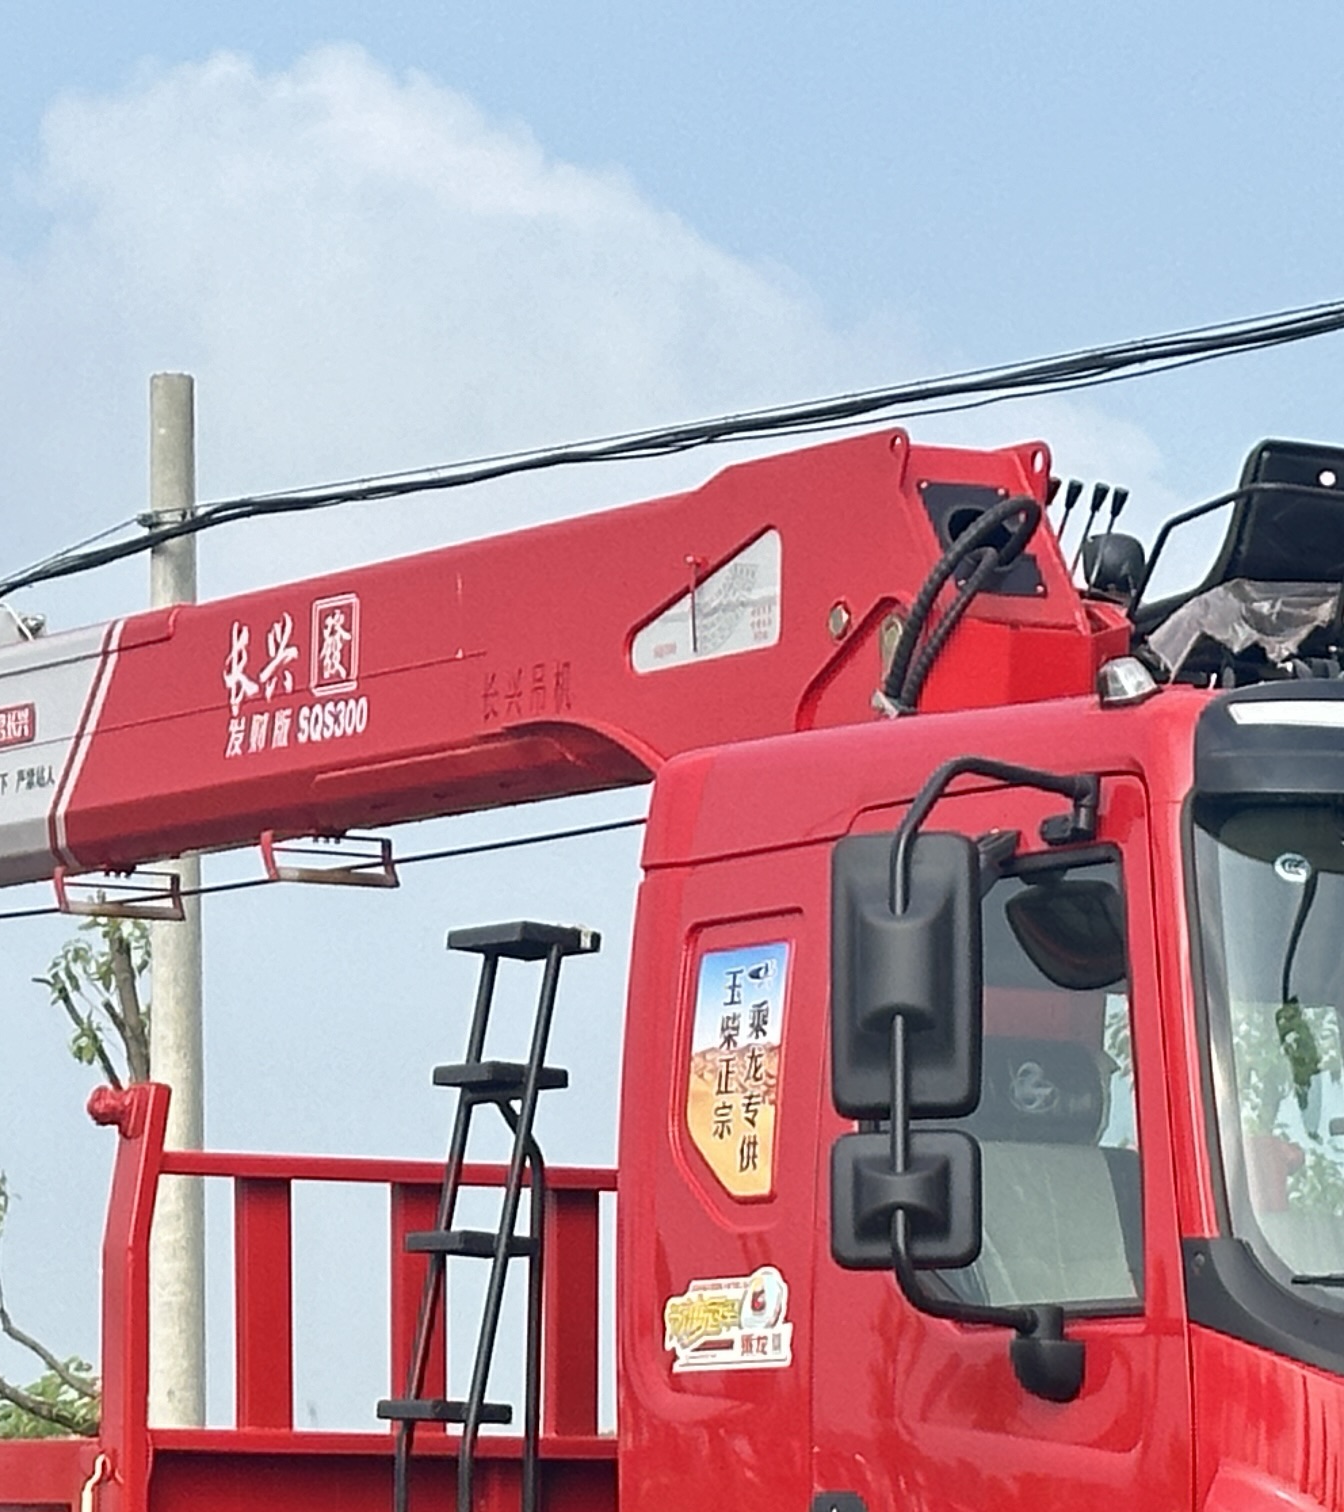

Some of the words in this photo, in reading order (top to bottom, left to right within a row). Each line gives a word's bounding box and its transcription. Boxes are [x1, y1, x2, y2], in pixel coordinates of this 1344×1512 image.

[223, 611, 299, 717] 长兴
[296, 696, 368, 743] SQS300
[712, 968, 745, 1140] 玉柴正宗
[739, 1000, 769, 1173] 乘龙专供
